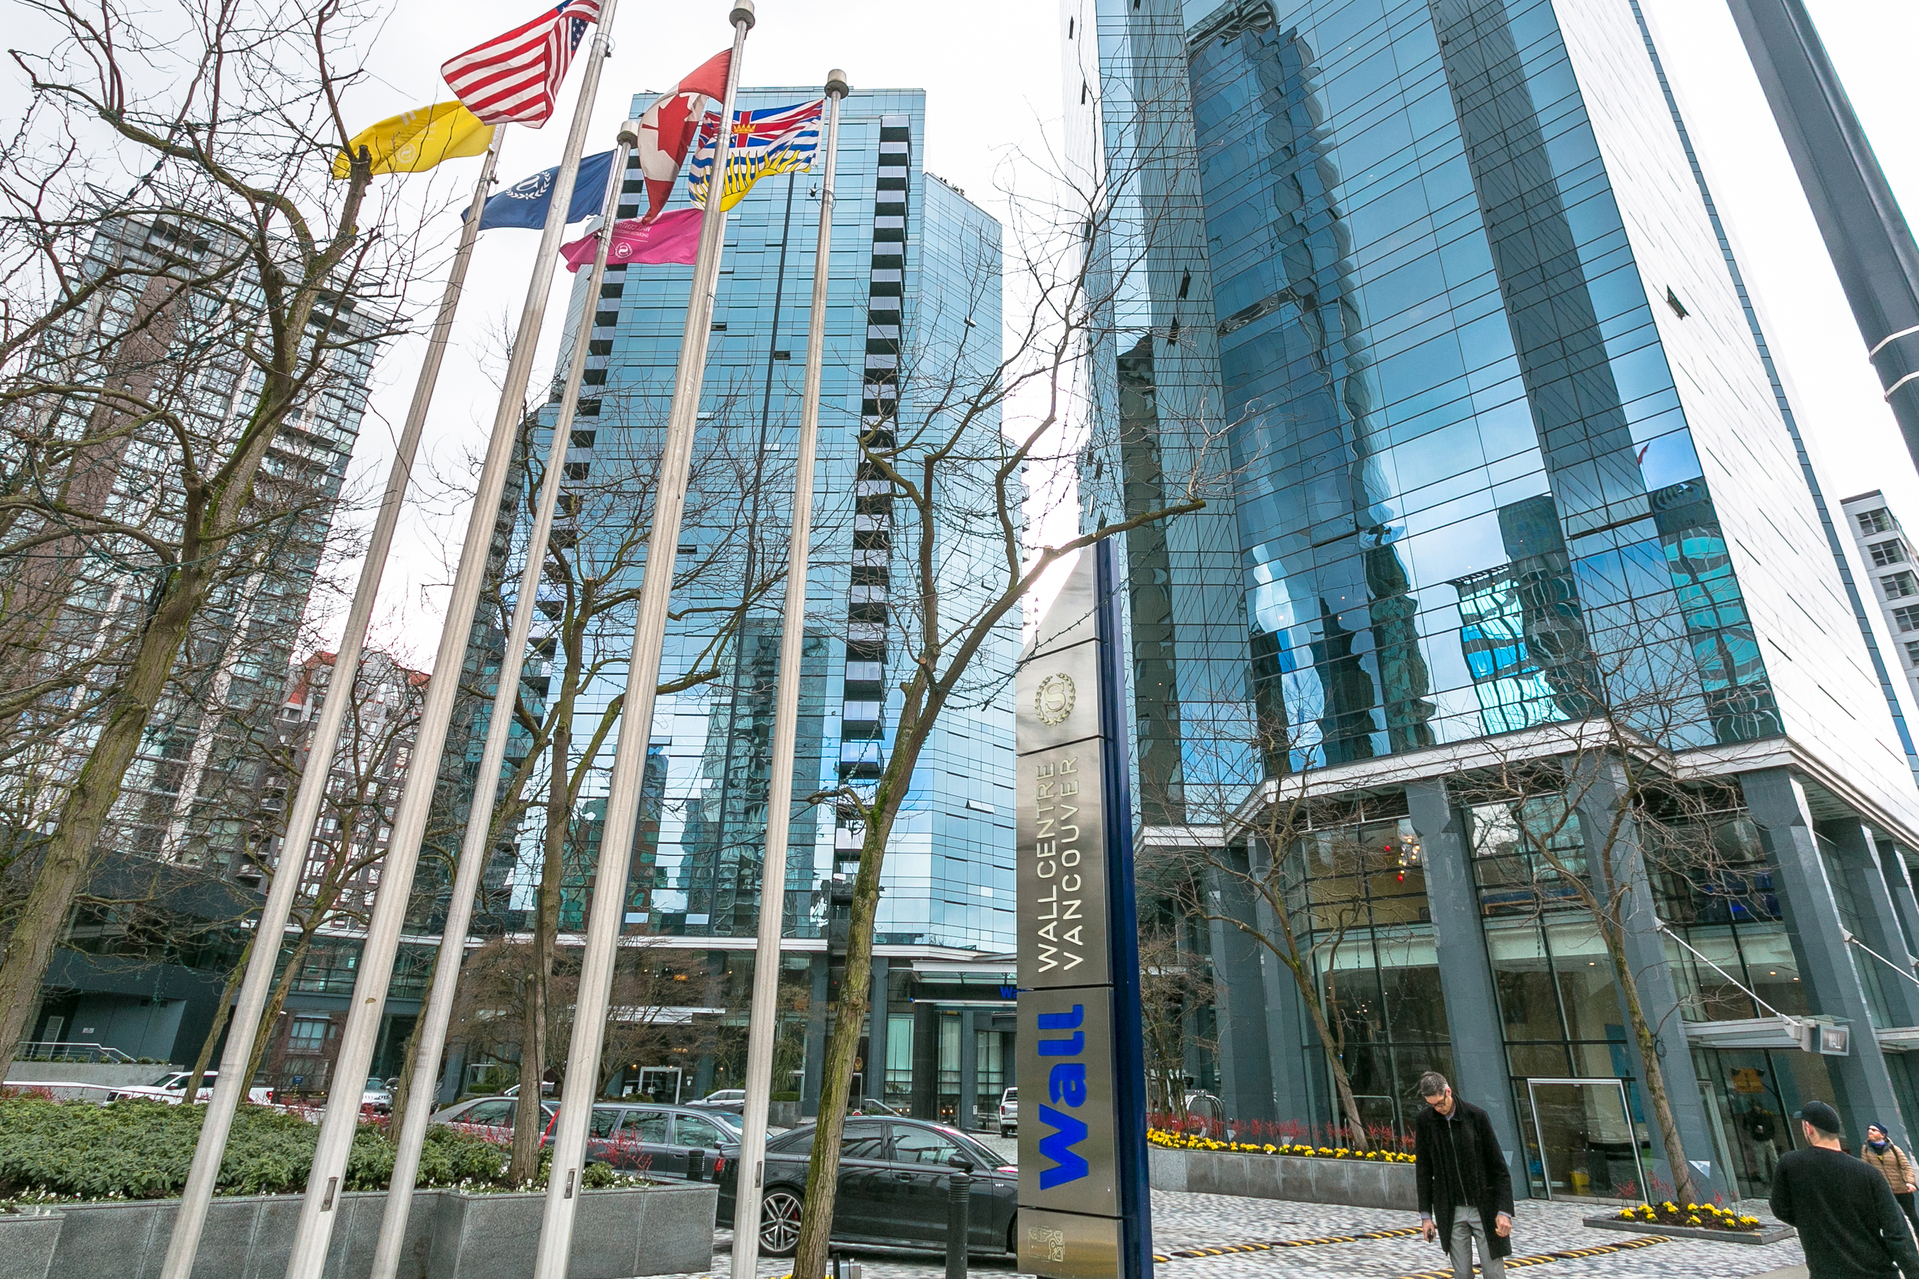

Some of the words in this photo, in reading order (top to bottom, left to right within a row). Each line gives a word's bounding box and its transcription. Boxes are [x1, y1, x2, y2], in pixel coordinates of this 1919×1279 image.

[1036, 762, 1057, 879] CENTRE
[1059, 757, 1084, 971] VANCOUVER
[1037, 885, 1058, 972] WALL
[999, 986, 1018, 999] Wa
[1038, 1004, 1089, 1191] Wall
